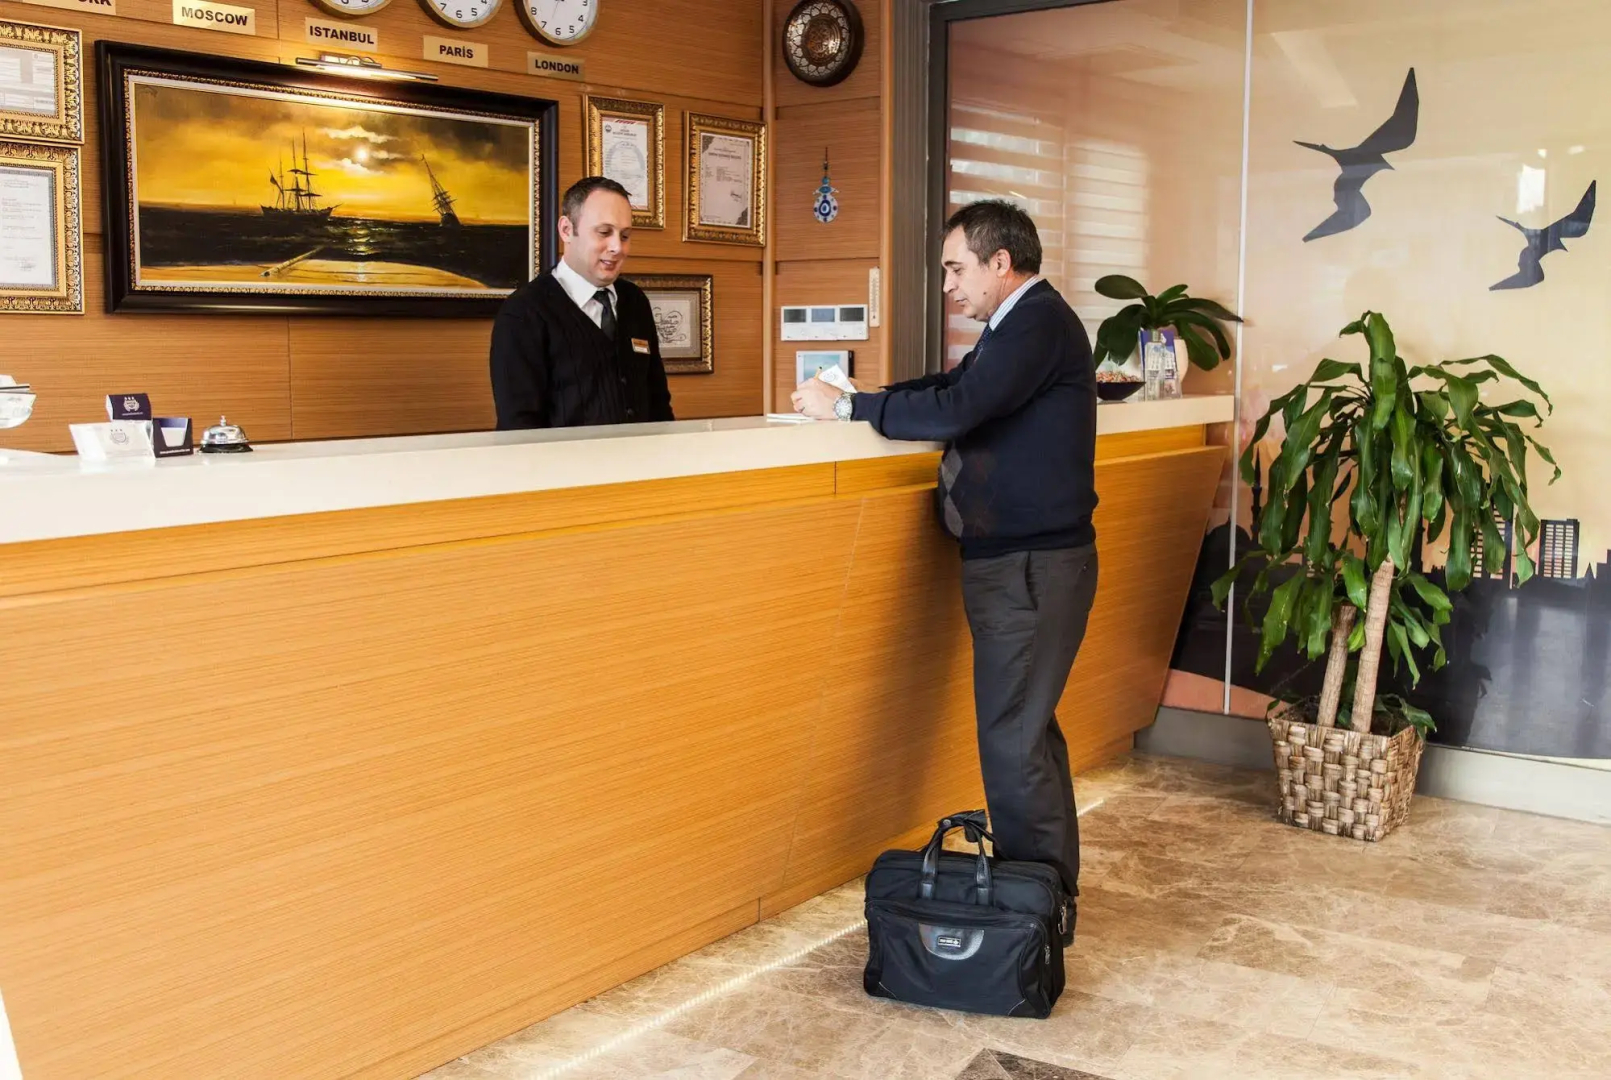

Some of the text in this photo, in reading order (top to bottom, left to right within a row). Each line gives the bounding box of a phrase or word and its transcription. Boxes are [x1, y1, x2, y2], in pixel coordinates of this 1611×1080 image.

[440, 2, 447, 11] 7
[530, 6, 537, 15] 8
[181, 6, 248, 26] MOSCOW
[455, 9, 463, 19] 6
[471, 7, 478, 16] 5
[577, 14, 584, 22] 4
[541, 20, 547, 28] 7
[555, 27, 562, 36] 6
[569, 25, 575, 34] 5
[309, 25, 374, 44] ISTANBUL
[439, 44, 474, 59] PARİS
[535, 59, 579, 75] LONDON
